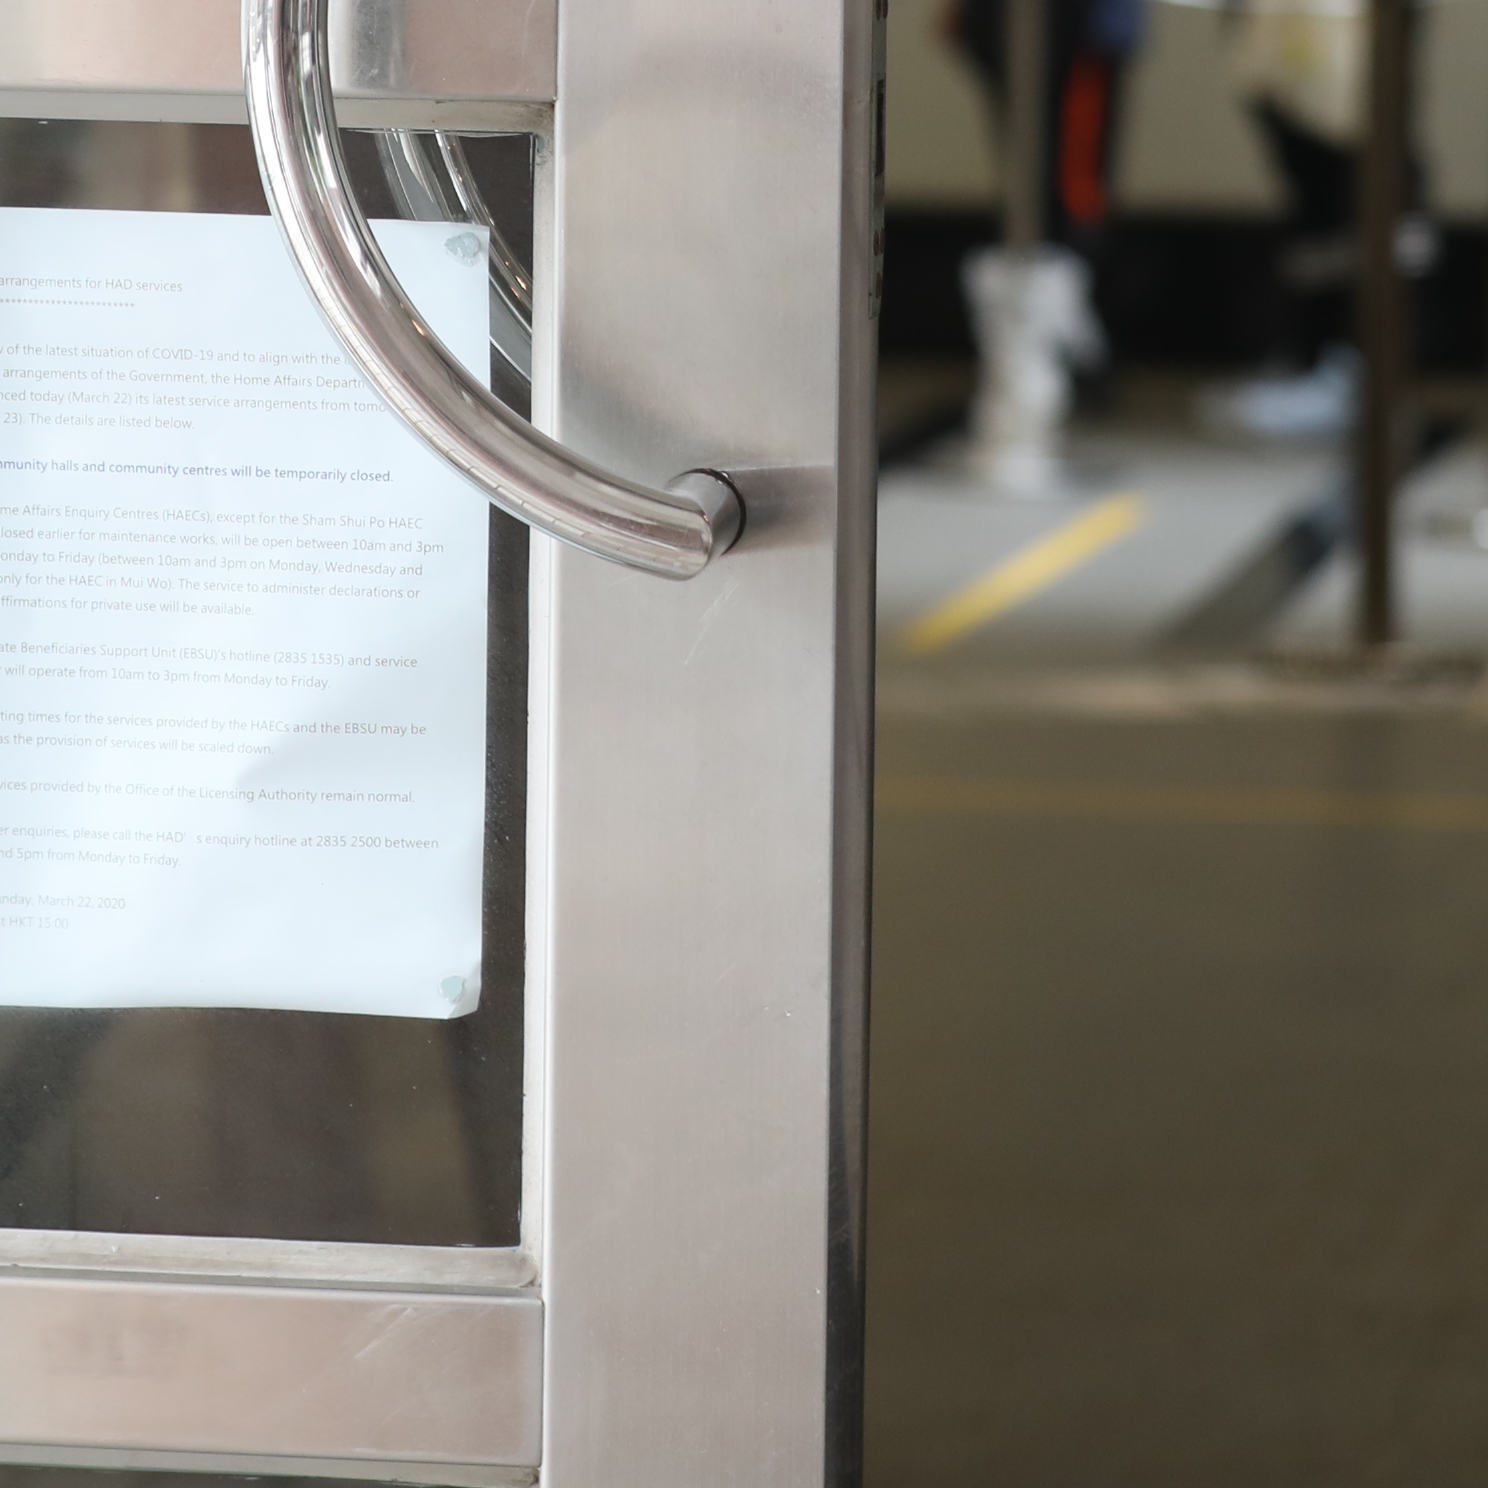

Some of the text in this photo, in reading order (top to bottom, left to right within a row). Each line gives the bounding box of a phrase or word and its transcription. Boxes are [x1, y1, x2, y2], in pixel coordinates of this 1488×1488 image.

[85, 277, 102, 289] for
[106, 278, 132, 290] HAD
[136, 281, 183, 292] services
[3, 369, 87, 381] arrangements
[91, 368, 103, 380] of
[106, 368, 125, 382] the
[129, 369, 207, 385] Government,
[211, 372, 230, 384] the
[234, 374, 270, 386] Home
[273, 374, 312, 388] Affairs
[52, 459, 78, 472] halls
[82, 460, 105, 472] and
[109, 463, 179, 478] community
[183, 465, 227, 477] centres
[231, 465, 251, 478] will
[256, 465, 270, 478] be
[275, 467, 347, 483] temporarily
[350, 469, 393, 482] closed.
[22, 503, 61, 517] Affairs
[65, 505, 110, 521] Enquiry
[113, 507, 159, 520] Centres
[162, 509, 213, 524] (HAECs),
[217, 513, 255, 526] except
[259, 511, 276, 524] for
[279, 513, 298, 525] the
[302, 513, 336, 526] Sham
[340, 514, 365, 528] Shui
[370, 516, 385, 529] Po
[389, 517, 423, 530] HAEC
[21, 642, 96, 656] Beneficiaries
[100, 644, 148, 659] Support
[152, 646, 176, 659] Unit
[230, 649, 270, 663] hotline
[274, 651, 307, 665] (2835
[312, 652, 344, 668] 1535)
[348, 654, 371, 667] and
[375, 655, 418, 668] service
[30, 780, 83, 794] provided
[87, 781, 101, 796] by
[105, 782, 122, 794] the
[125, 783, 159, 796] Office
[162, 785, 174, 797] of
[178, 785, 195, 798] the
[200, 785, 254, 803] Licensing
[258, 788, 317, 804] Authority
[321, 789, 364, 802] remain
[368, 791, 414, 803] normal.
